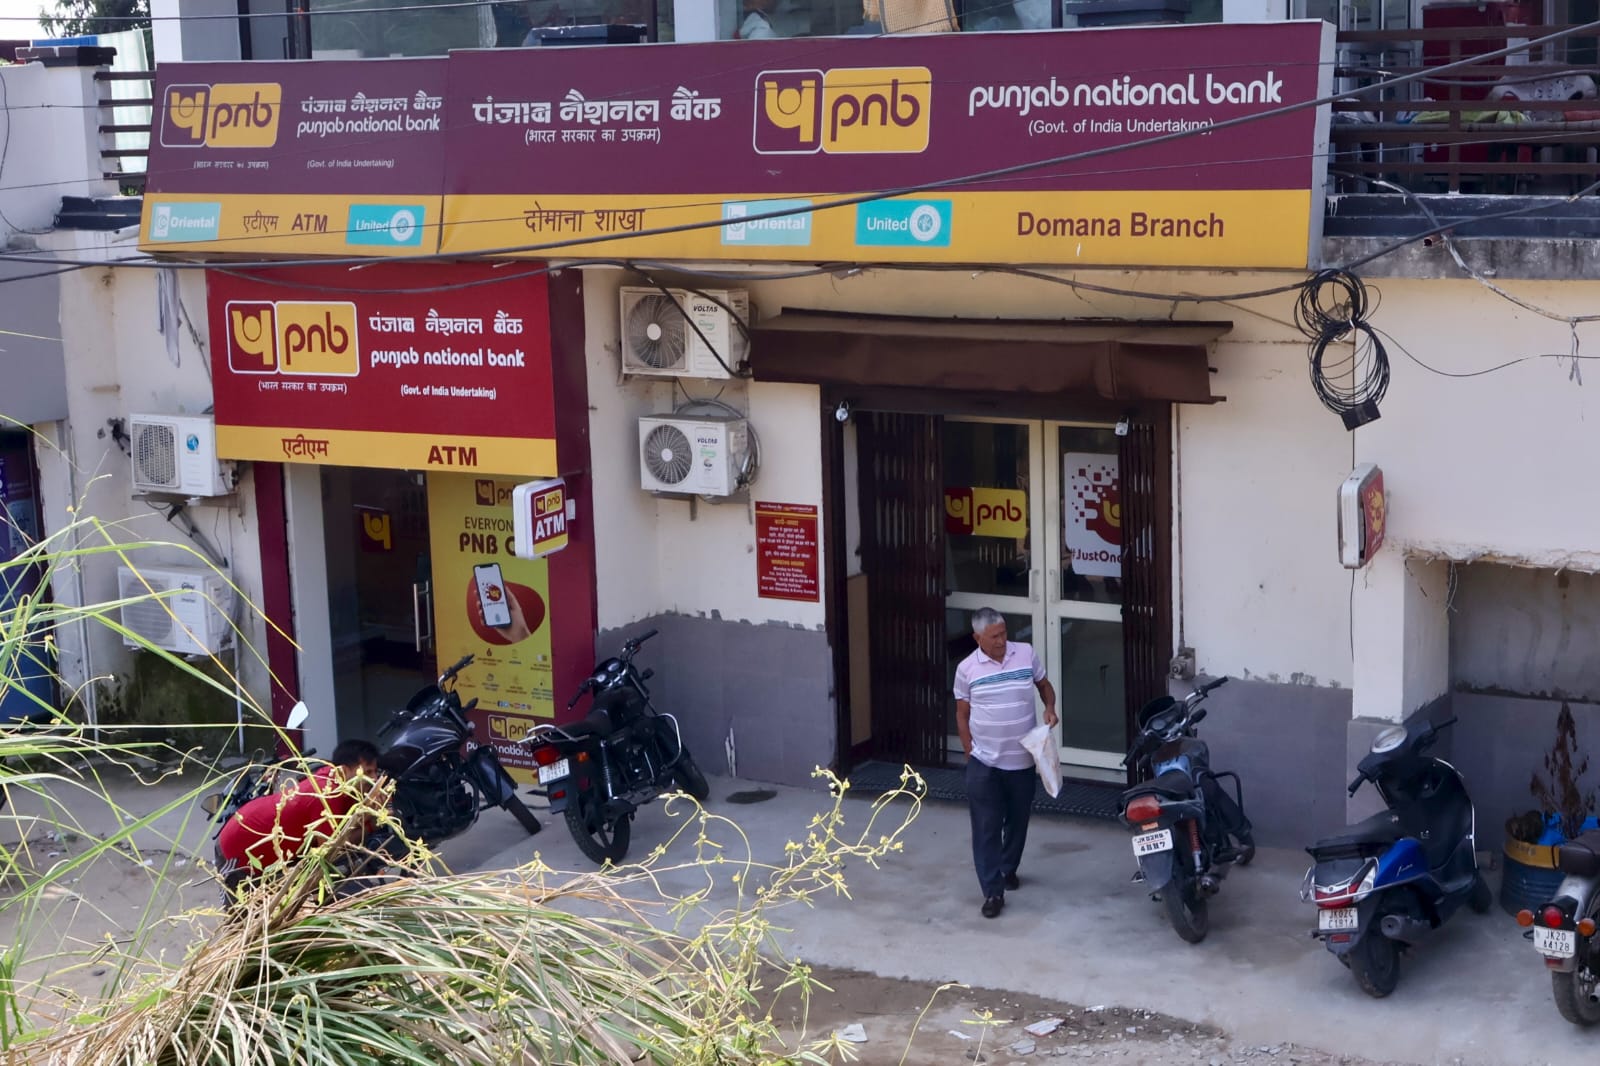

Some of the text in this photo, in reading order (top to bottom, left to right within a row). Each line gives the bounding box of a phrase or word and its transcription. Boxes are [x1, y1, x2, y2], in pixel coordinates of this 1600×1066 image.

[300, 95, 346, 114] पंजाब
[968, 70, 1283, 117] punjab national bank
[212, 91, 273, 139] pnb
[472, 85, 722, 126] पंजाब नैशनल बैंक
[830, 78, 921, 142] pnb
[297, 114, 441, 139] punjab national bank
[525, 127, 661, 146] (भारत सरकार का उपक्रम)
[1028, 117, 1215, 136] (Govt. of India Undertaking)
[327, 159, 335, 169] of
[336, 159, 352, 168] India
[353, 158, 395, 169] Undertaking)
[170, 215, 215, 229] Oriental
[243, 210, 279, 233] एटीएम
[291, 213, 328, 233] ATM
[355, 218, 389, 233] United
[523, 201, 646, 233] दोमाना शाखा
[866, 216, 909, 232] United
[1017, 211, 1225, 238] Domana Branch
[693, 305, 718, 313] VOLTAS
[369, 308, 523, 337] पंजाब नैशनल बैंक
[284, 311, 349, 366] pnb
[371, 347, 525, 369] punjab national bank
[400, 384, 497, 400] (Govt. of India Undertaking)
[281, 434, 330, 459] एटीएम
[427, 445, 478, 466] ATM
[547, 495, 561, 510] pnb
[976, 498, 1022, 527] pnb
[464, 516, 514, 532] EVERYON
[535, 513, 565, 540] ATM
[459, 533, 498, 555] PNB
